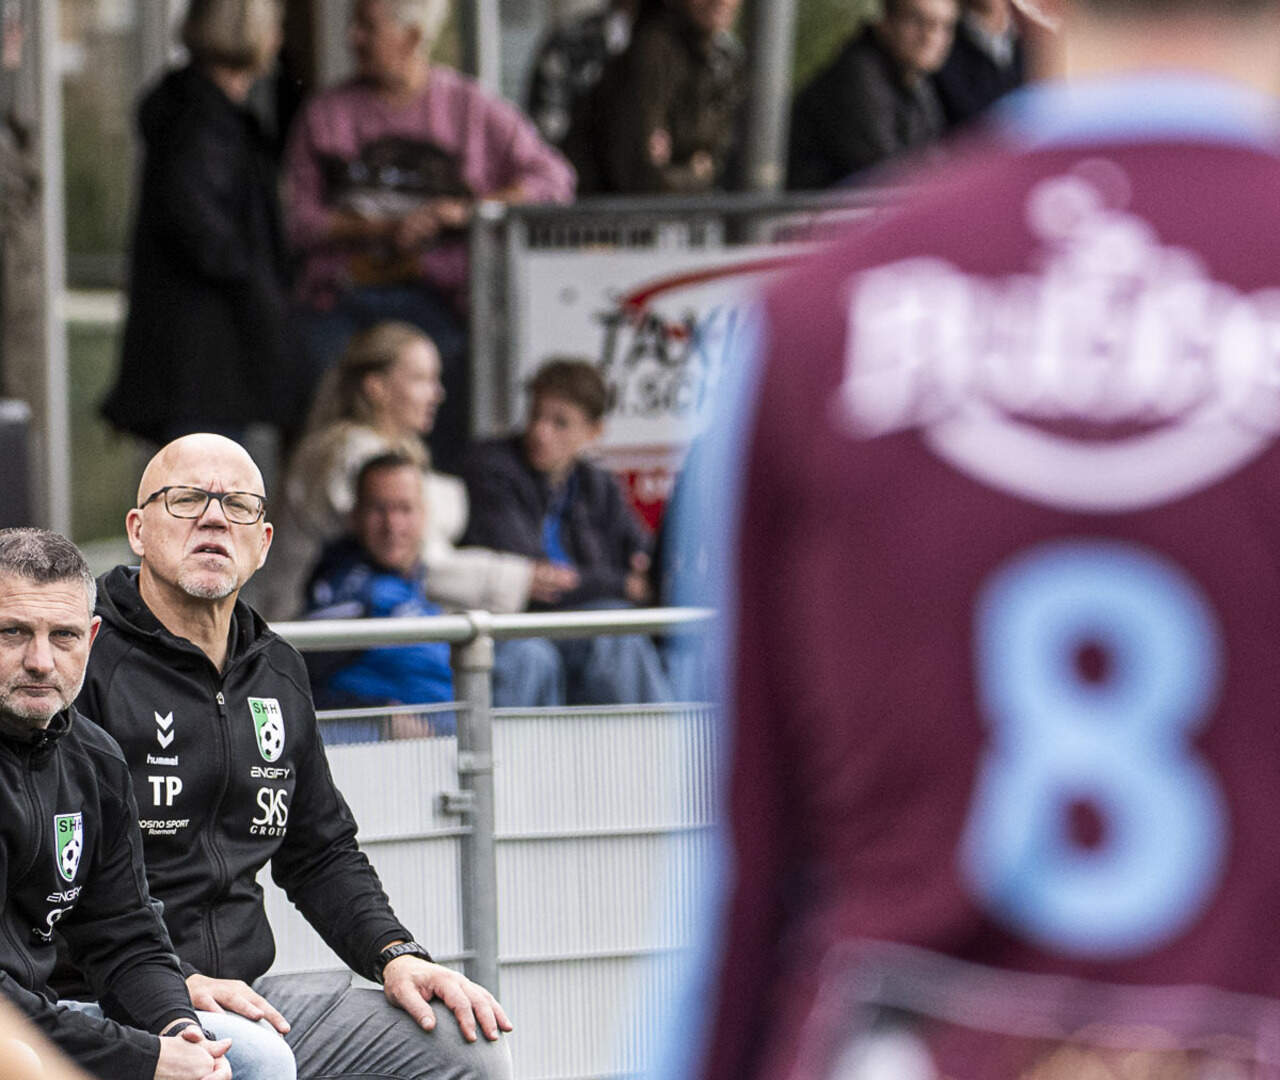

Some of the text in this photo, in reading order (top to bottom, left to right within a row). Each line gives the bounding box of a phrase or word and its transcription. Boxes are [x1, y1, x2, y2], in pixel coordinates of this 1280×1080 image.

[252, 702, 278, 714] SHH
[968, 545, 1225, 956] 8
[147, 775, 183, 806] TP
[166, 819, 190, 829] SPORT
